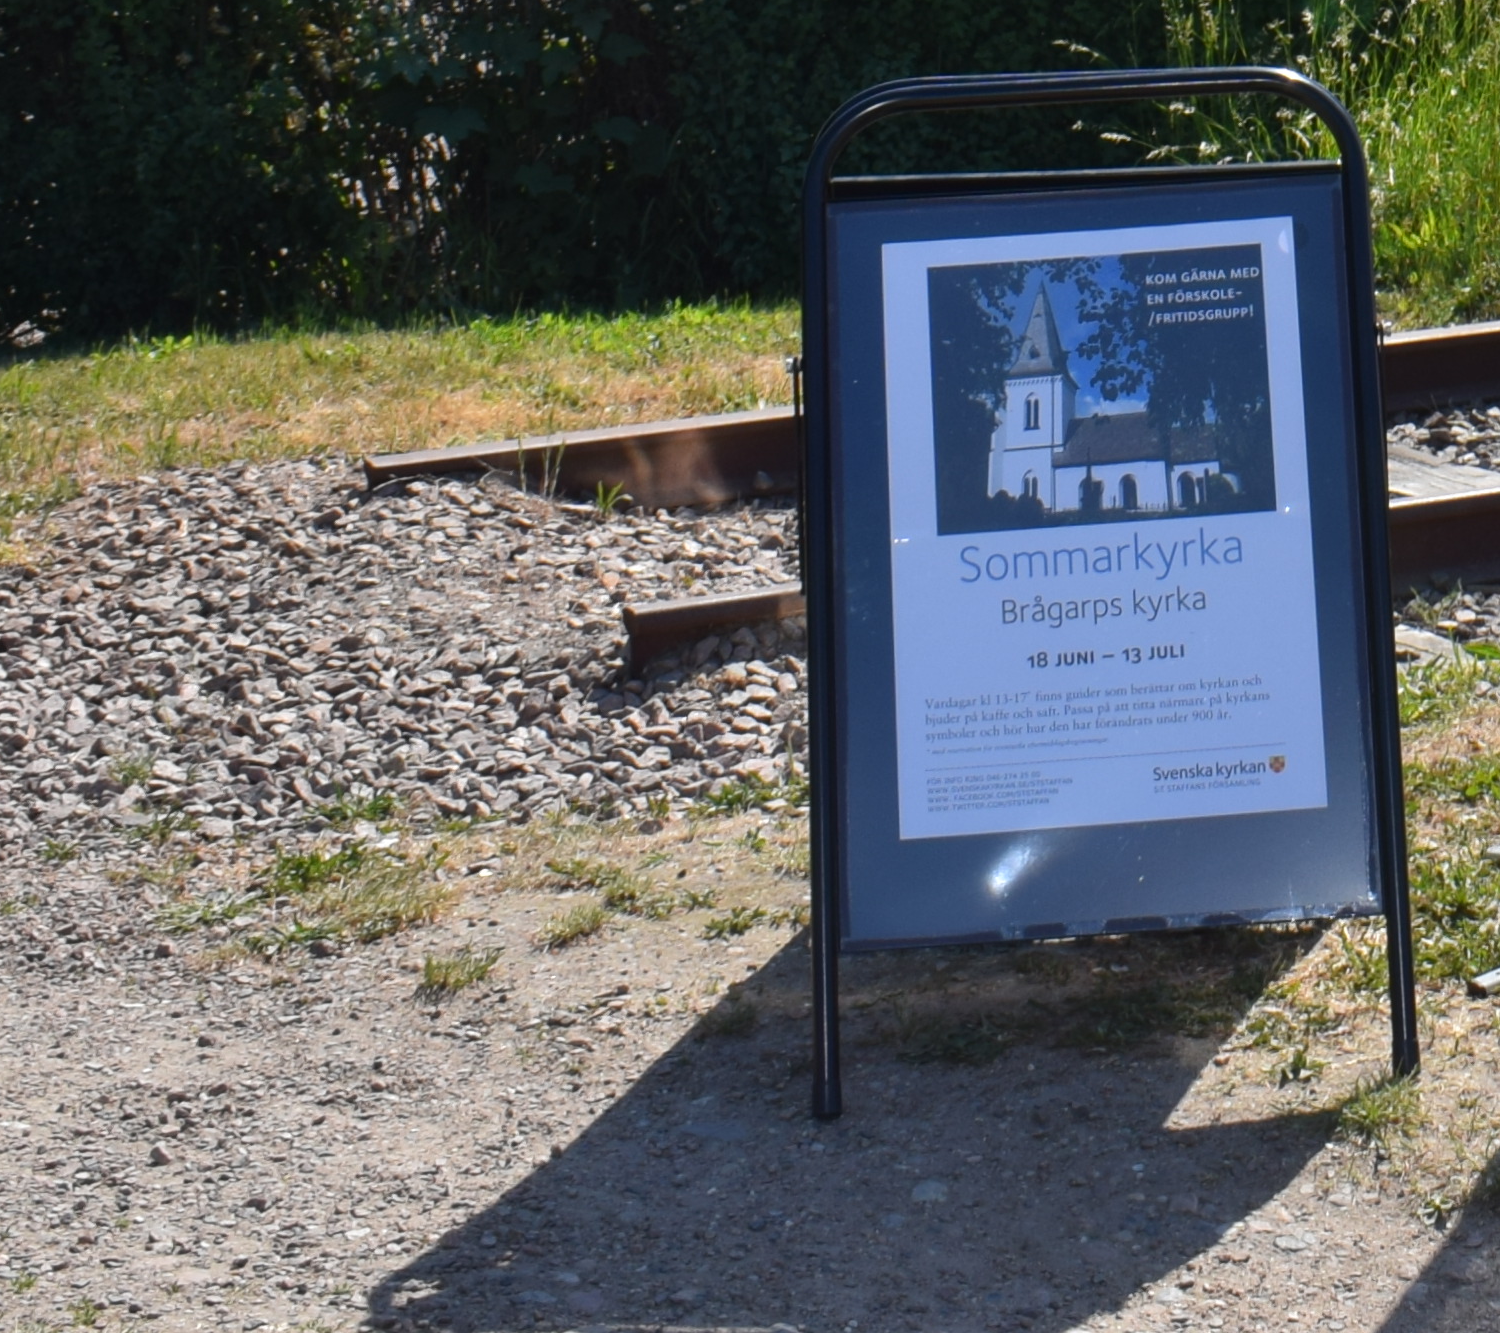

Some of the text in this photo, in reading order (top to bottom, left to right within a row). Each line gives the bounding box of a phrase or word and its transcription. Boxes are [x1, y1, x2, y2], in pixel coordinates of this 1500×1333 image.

[1145, 266, 1260, 286] KOM GÄRNA MED
[1147, 288, 1243, 305] EN FÖRSKOLE-
[1148, 303, 1254, 327] /FRITIDSGRUPP!
[959, 527, 1243, 583] Sommarkyrka
[1001, 585, 1207, 629] Brågarps kyrka
[1027, 652, 1049, 669] 18
[1055, 651, 1095, 667] JUNI
[1122, 648, 1142, 664] 13
[1148, 644, 1186, 661] JULI
[925, 697, 976, 710] Vardagar
[980, 694, 991, 706] kl
[1035, 690, 1062, 702] finns
[1066, 686, 1100, 702] guider
[1105, 687, 1127, 697] som
[1131, 682, 1174, 695] berättar
[1178, 683, 1197, 693] om
[1200, 677, 1238, 691] kyrkan
[1242, 674, 1262, 686] och
[925, 691, 1270, 727] bjuder på kaffe och saft. Passa på att titta närmare på kyrkans
[925, 708, 1232, 743] symboler och hör hur den har förändrats under 900 år.
[1153, 759, 1267, 781] Svenska kyrkan
[1167, 781, 1206, 793] STAFFANS
